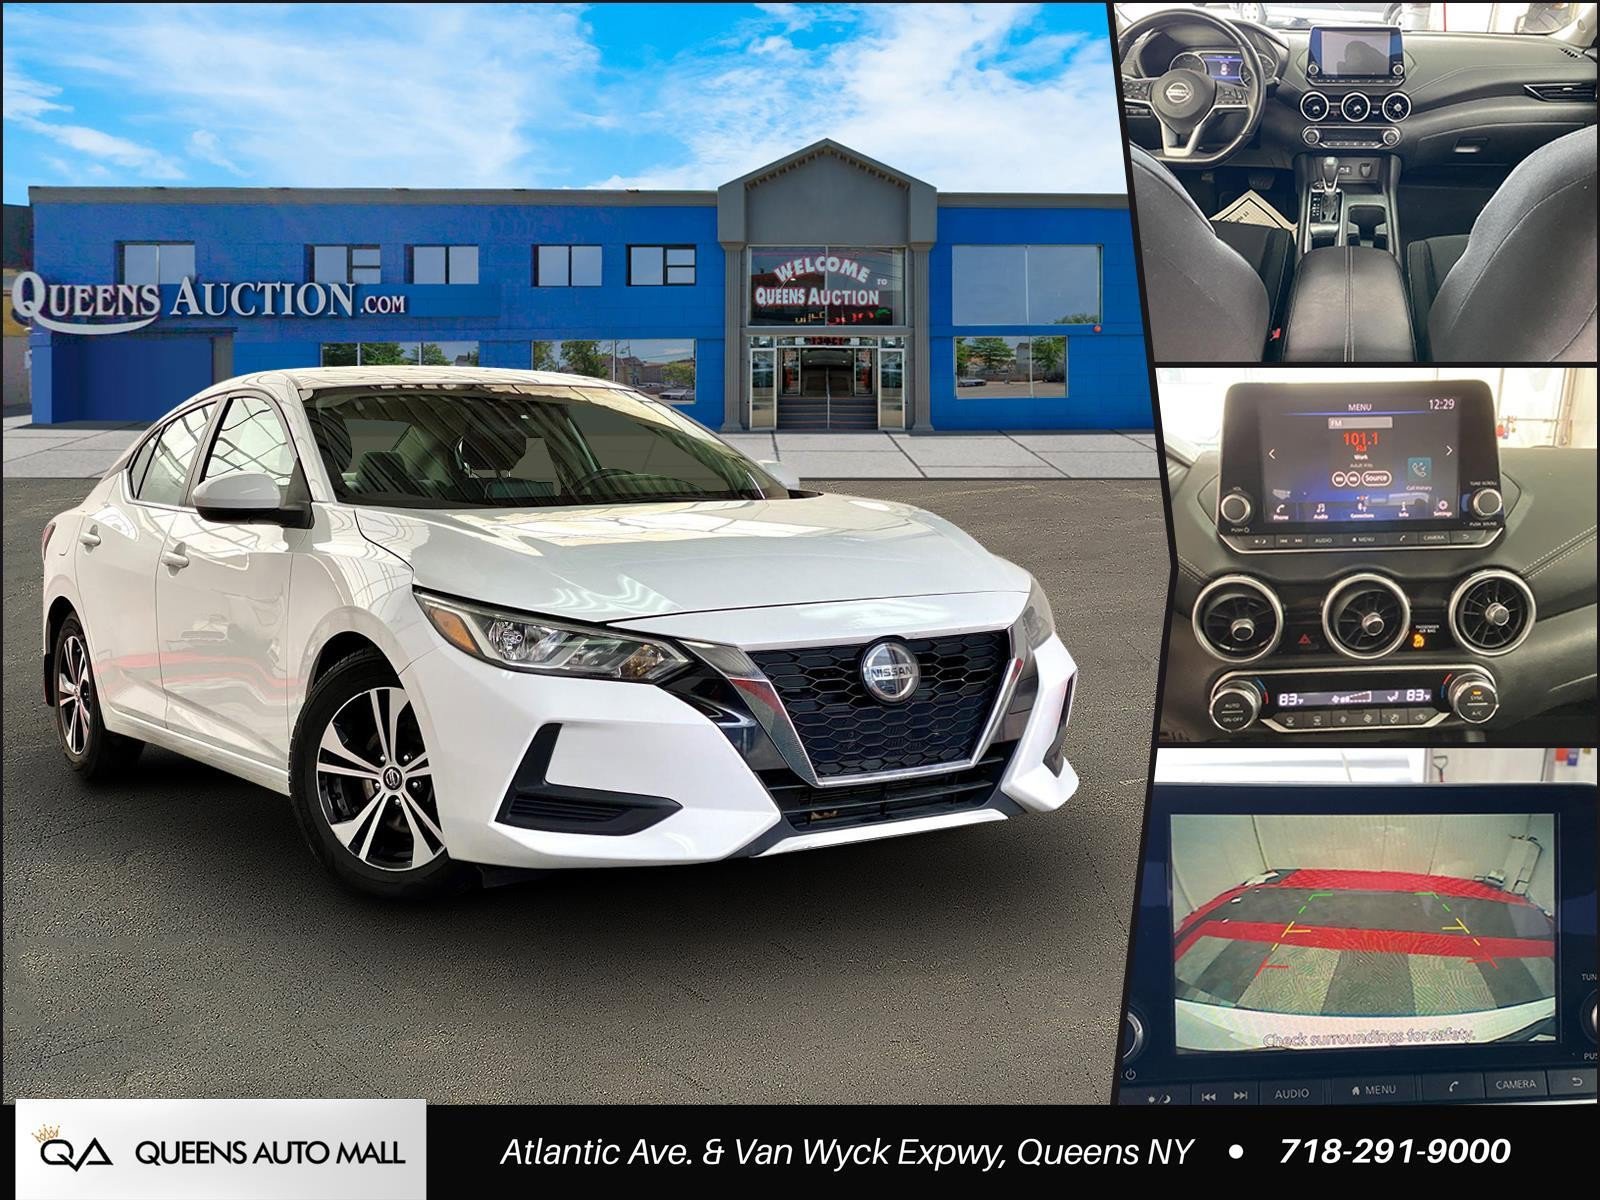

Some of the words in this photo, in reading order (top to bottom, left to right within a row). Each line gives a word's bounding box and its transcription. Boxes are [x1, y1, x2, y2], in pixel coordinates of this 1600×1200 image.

[774, 256, 870, 283] WELCOME
[877, 278, 888, 286] TO
[755, 287, 806, 306] QUEENS
[808, 288, 879, 306] AUCTION
[12, 271, 161, 335] QUEENS
[1347, 403, 1373, 412] MENU
[1428, 398, 1456, 410] 12:29
[1330, 420, 1343, 428] FM
[1343, 431, 1379, 446] 101.1
[1364, 473, 1388, 482] Source
[870, 665, 913, 678] NISSAN
[1263, 1032, 1307, 1047] Check
[1309, 1028, 1405, 1046] surroundings
[1406, 1027, 1427, 1042] for
[1430, 1026, 1476, 1043] safety.
[1365, 1084, 1397, 1095] MENU
[1495, 1079, 1537, 1090] CAMERA
[1274, 1087, 1310, 1099] AUDIO
